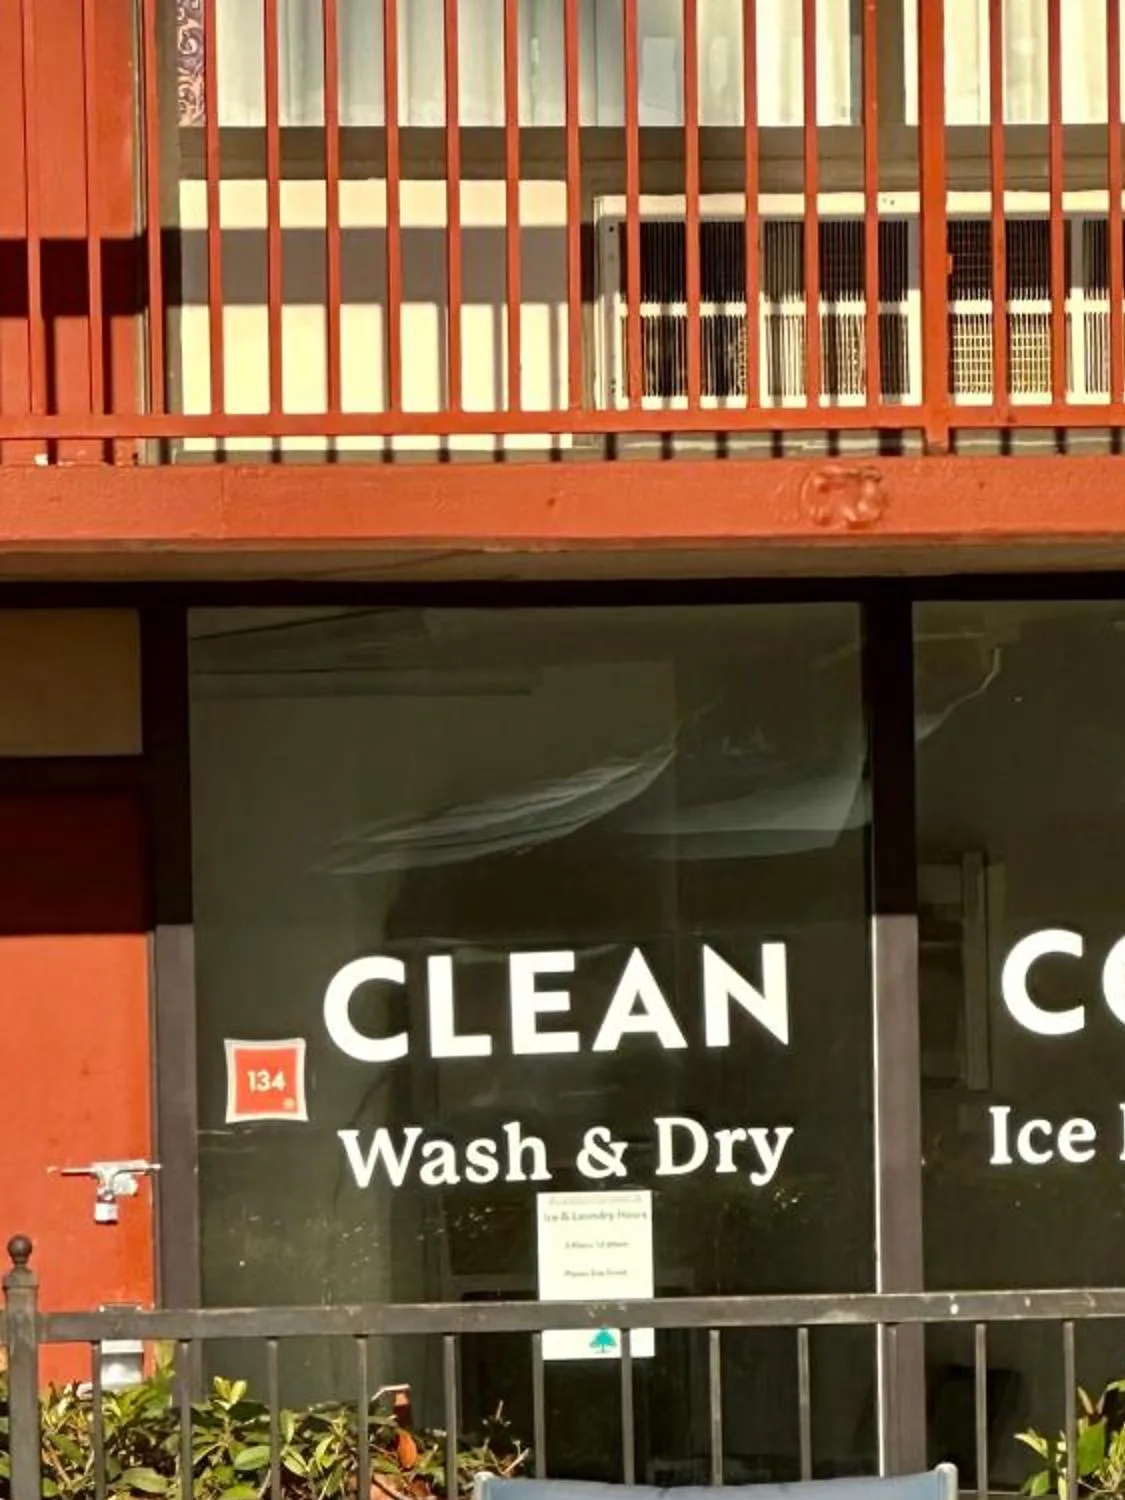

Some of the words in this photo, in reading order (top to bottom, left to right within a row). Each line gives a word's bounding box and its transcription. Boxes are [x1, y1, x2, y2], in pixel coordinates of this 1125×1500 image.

[323, 942, 789, 1062] CLEAN
[247, 1068, 287, 1093] 134
[337, 1119, 552, 1189] Wash
[576, 1126, 628, 1179] &
[654, 1117, 794, 1186] Dry
[989, 1106, 1097, 1165] Ice
